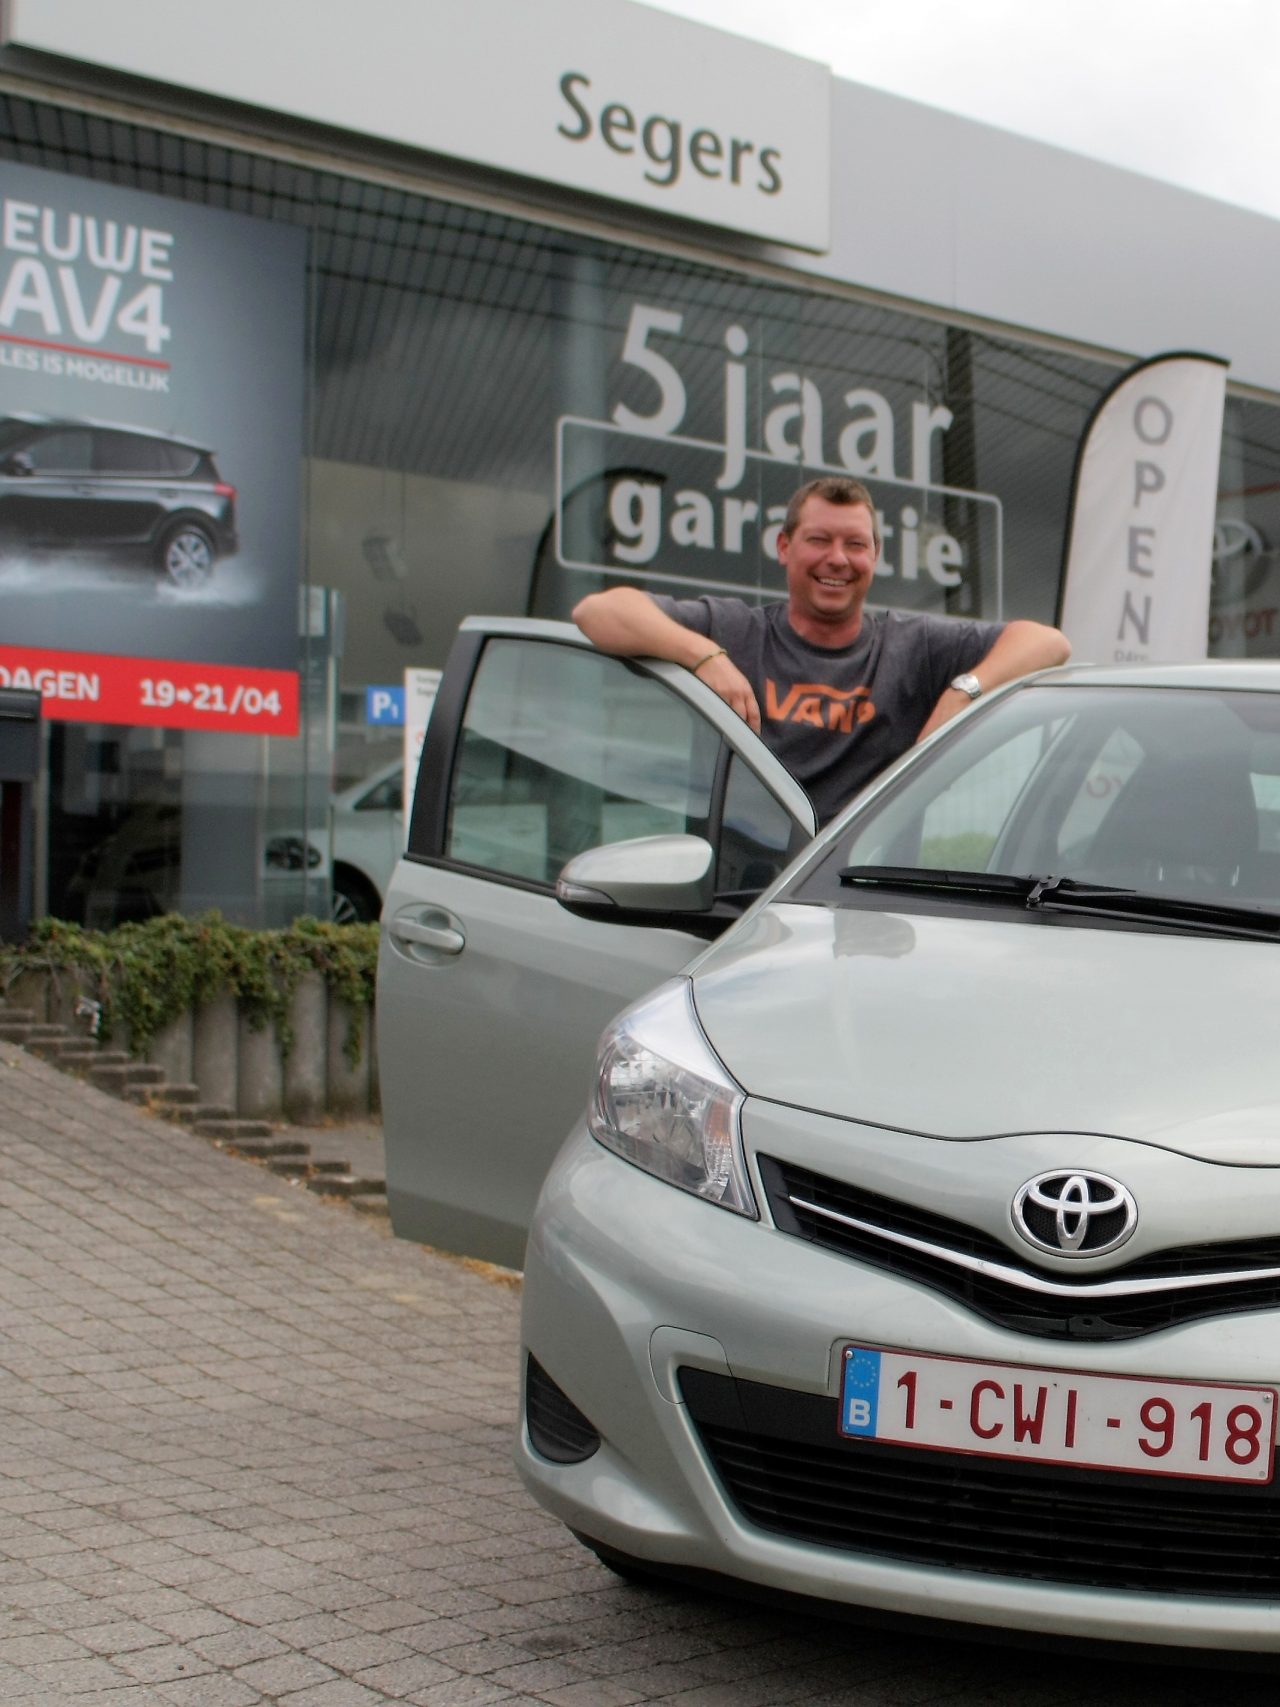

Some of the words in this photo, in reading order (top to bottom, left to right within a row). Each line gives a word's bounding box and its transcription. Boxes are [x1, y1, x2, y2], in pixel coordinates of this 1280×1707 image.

[557, 72, 784, 197] Segers
[3, 198, 175, 282] EUWE
[0, 256, 172, 354] AV4
[42, 352, 64, 376] IS
[612, 303, 687, 438] 5
[715, 324, 954, 491] jaar
[608, 475, 966, 588] garatie
[1116, 395, 1174, 646] OPEN
[848, 1399, 871, 1427] B
